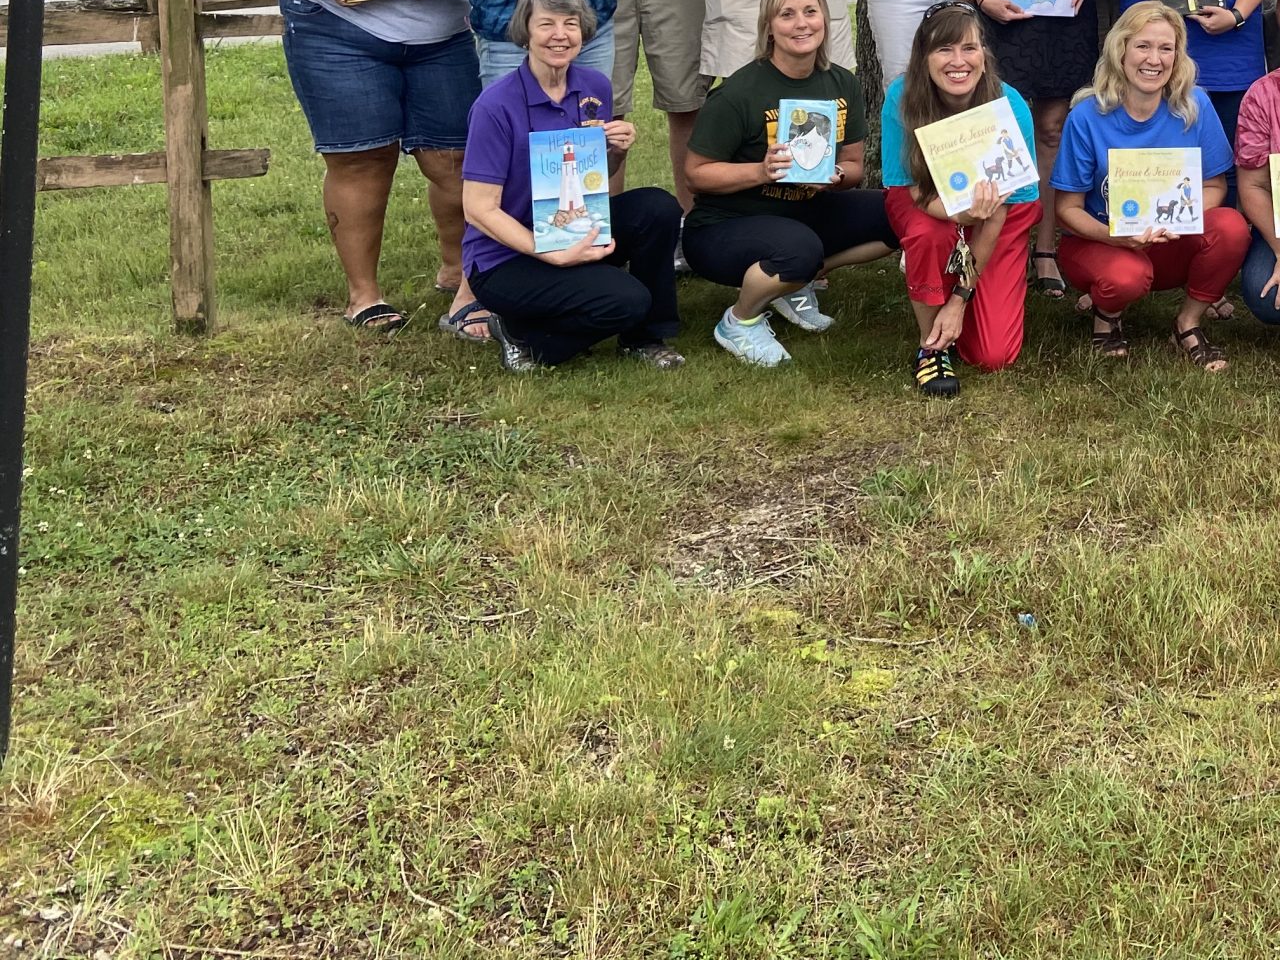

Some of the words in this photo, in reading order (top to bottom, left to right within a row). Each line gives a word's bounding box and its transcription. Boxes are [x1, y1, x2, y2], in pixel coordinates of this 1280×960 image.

[928, 137, 958, 157] Rescue
[969, 124, 997, 142] Jessica
[540, 149, 599, 179] LIGHTHOUSE
[1114, 167, 1142, 178] Rescue
[1152, 166, 1182, 178] Jessica
